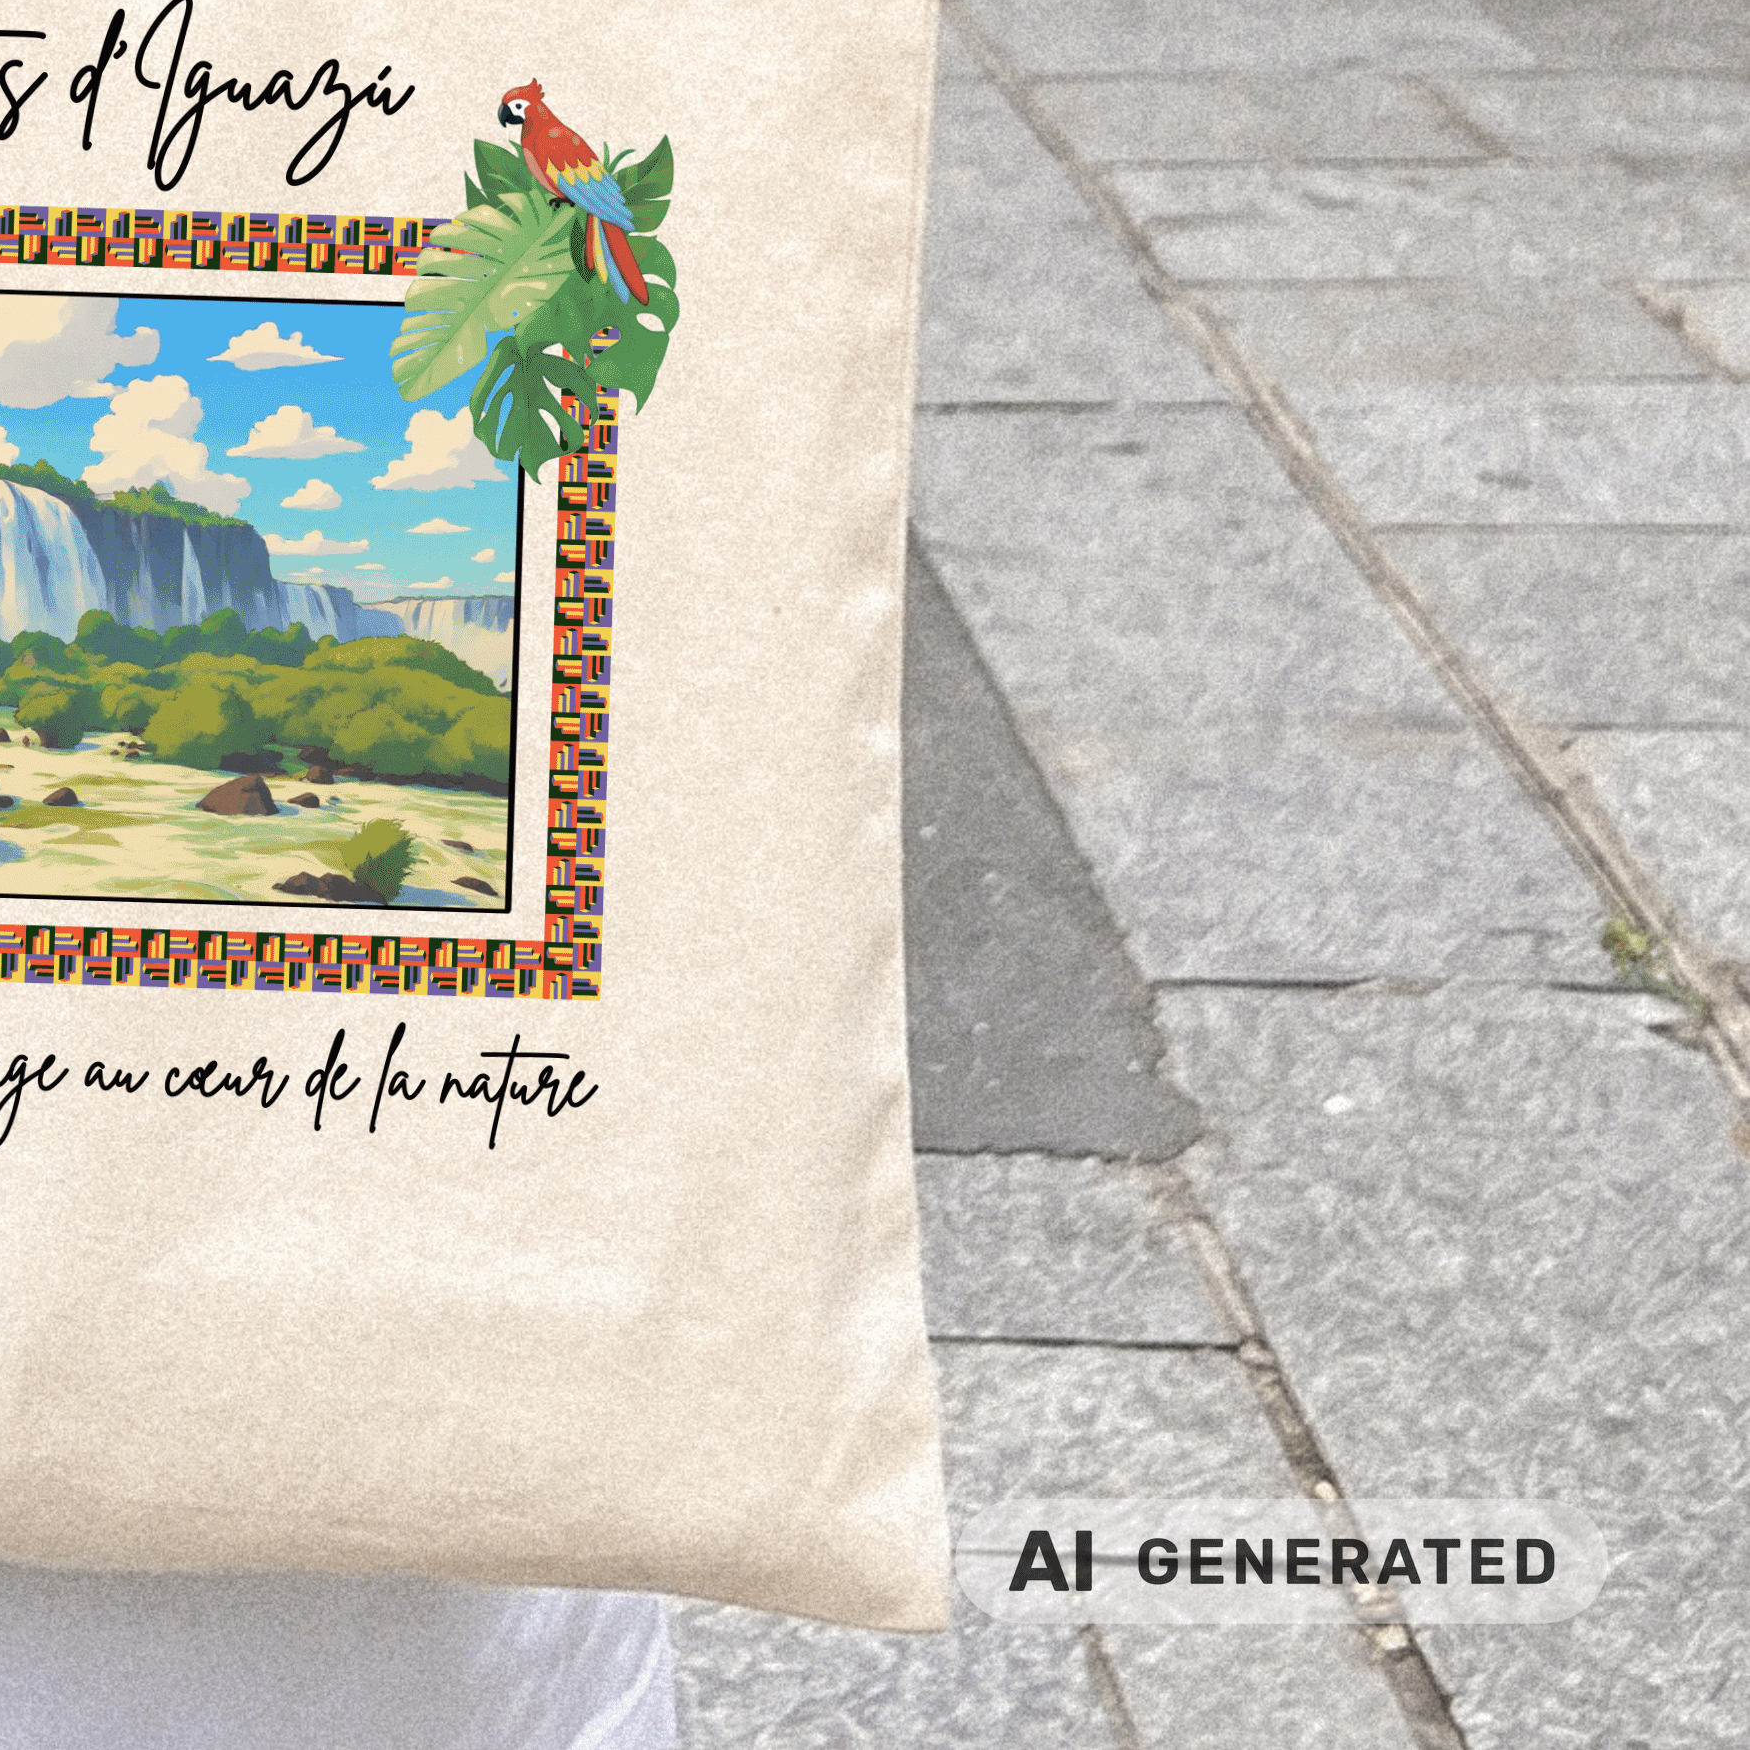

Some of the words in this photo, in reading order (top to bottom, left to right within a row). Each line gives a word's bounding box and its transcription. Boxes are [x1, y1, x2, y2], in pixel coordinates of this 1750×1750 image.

[84, 1061, 150, 1095] au
[164, 1056, 290, 1110] cœur
[304, 1028, 362, 1132] de
[369, 1021, 427, 1134] la
[439, 1033, 599, 1150] nature
